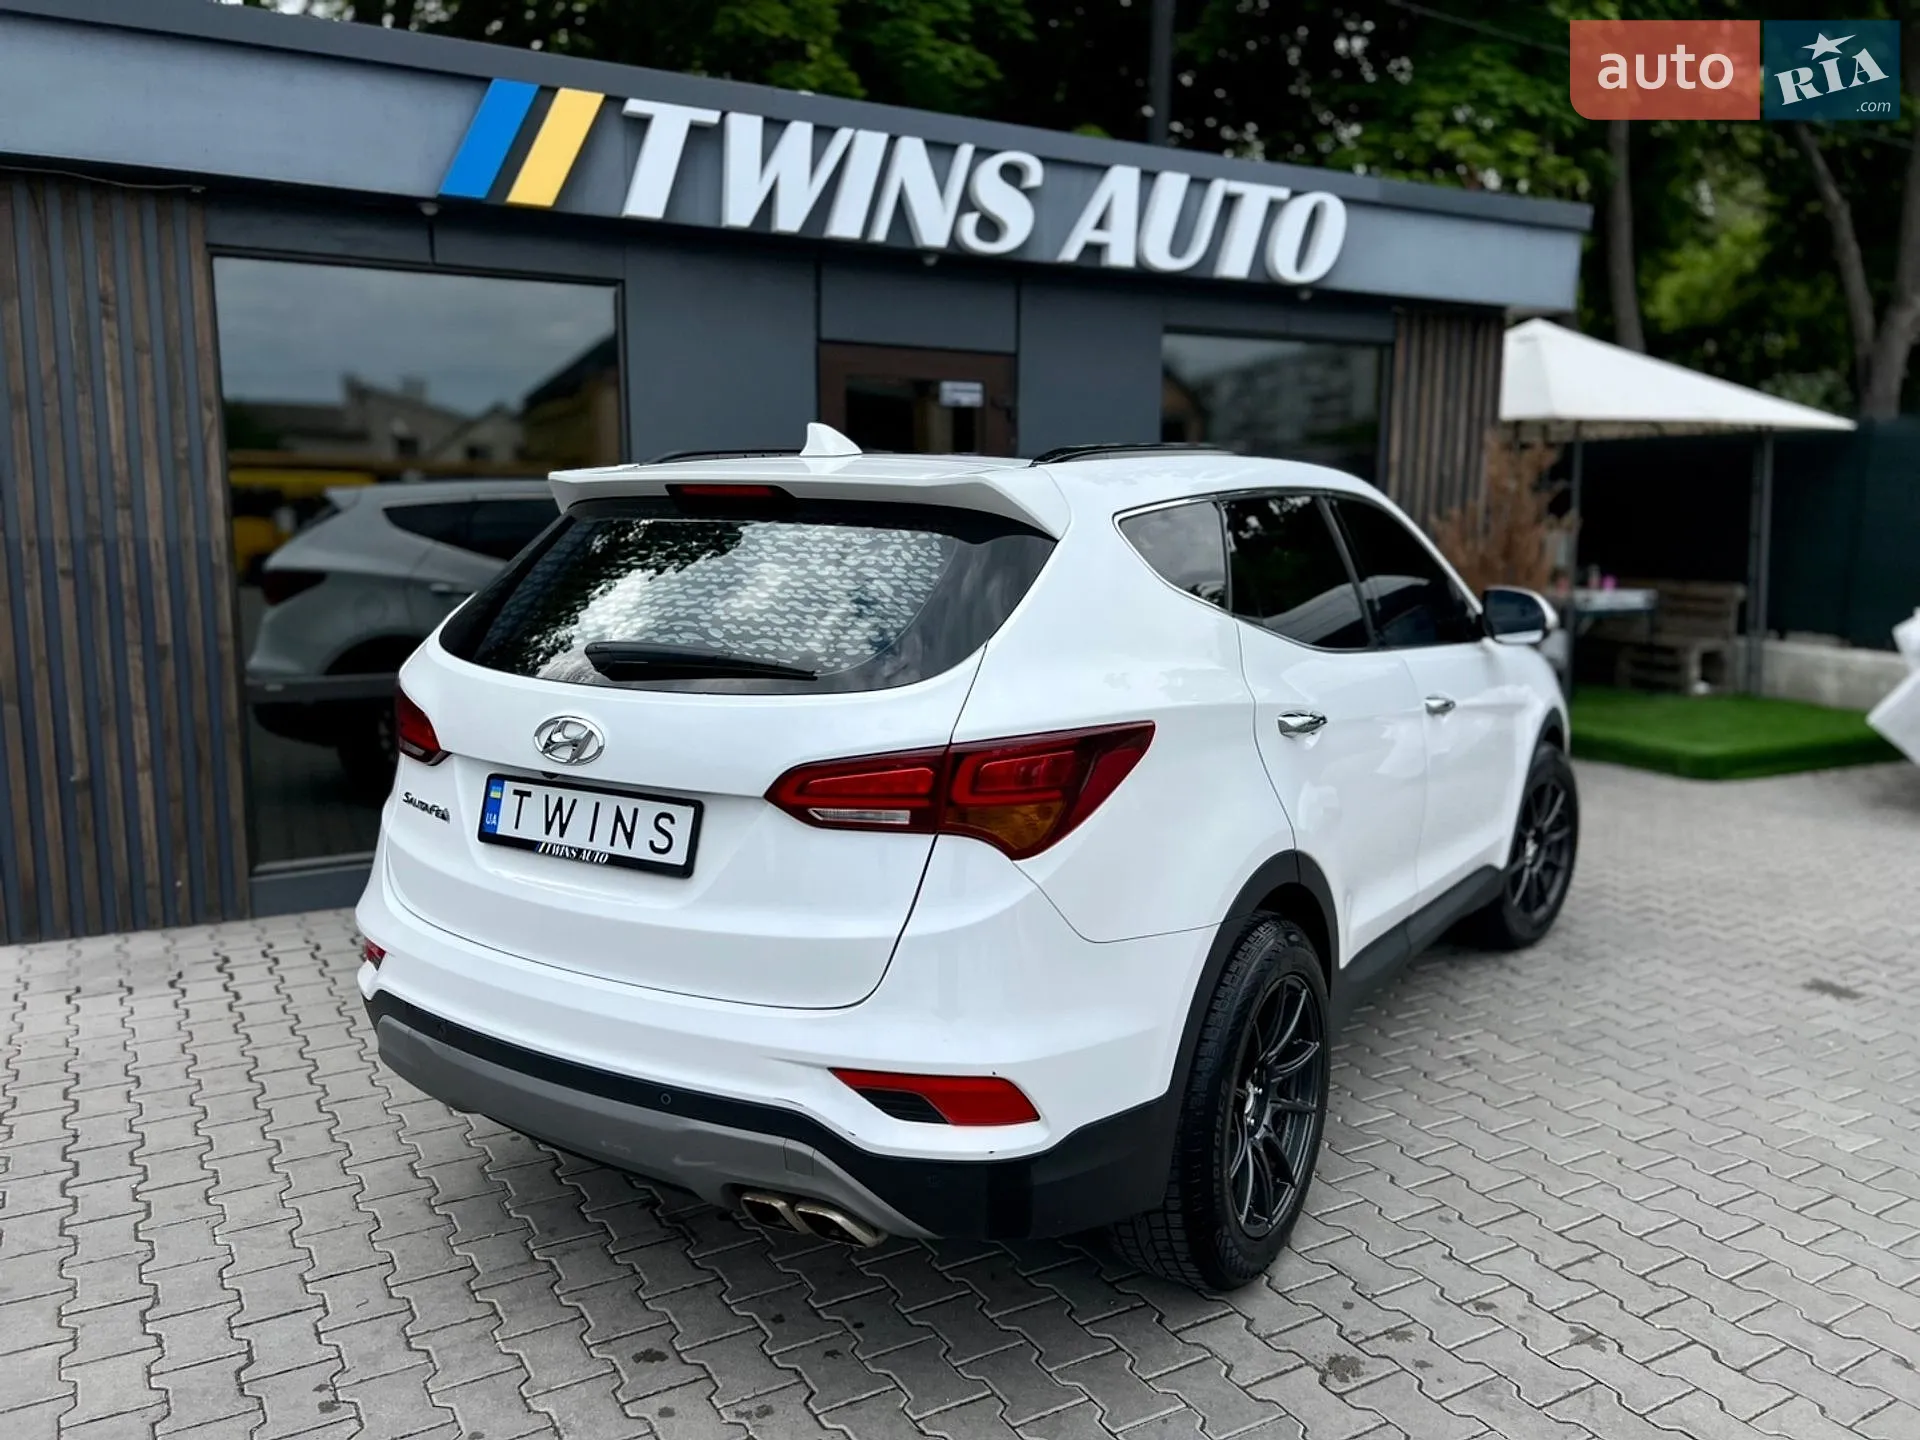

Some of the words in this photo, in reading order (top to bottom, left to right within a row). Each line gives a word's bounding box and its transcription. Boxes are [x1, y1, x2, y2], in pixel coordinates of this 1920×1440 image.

[621, 98, 1043, 255] TWINS
[1057, 164, 1347, 285] AUTO
[485, 812, 498, 825] UA
[512, 789, 676, 855] TWINS
[580, 849, 609, 863] AUTO
